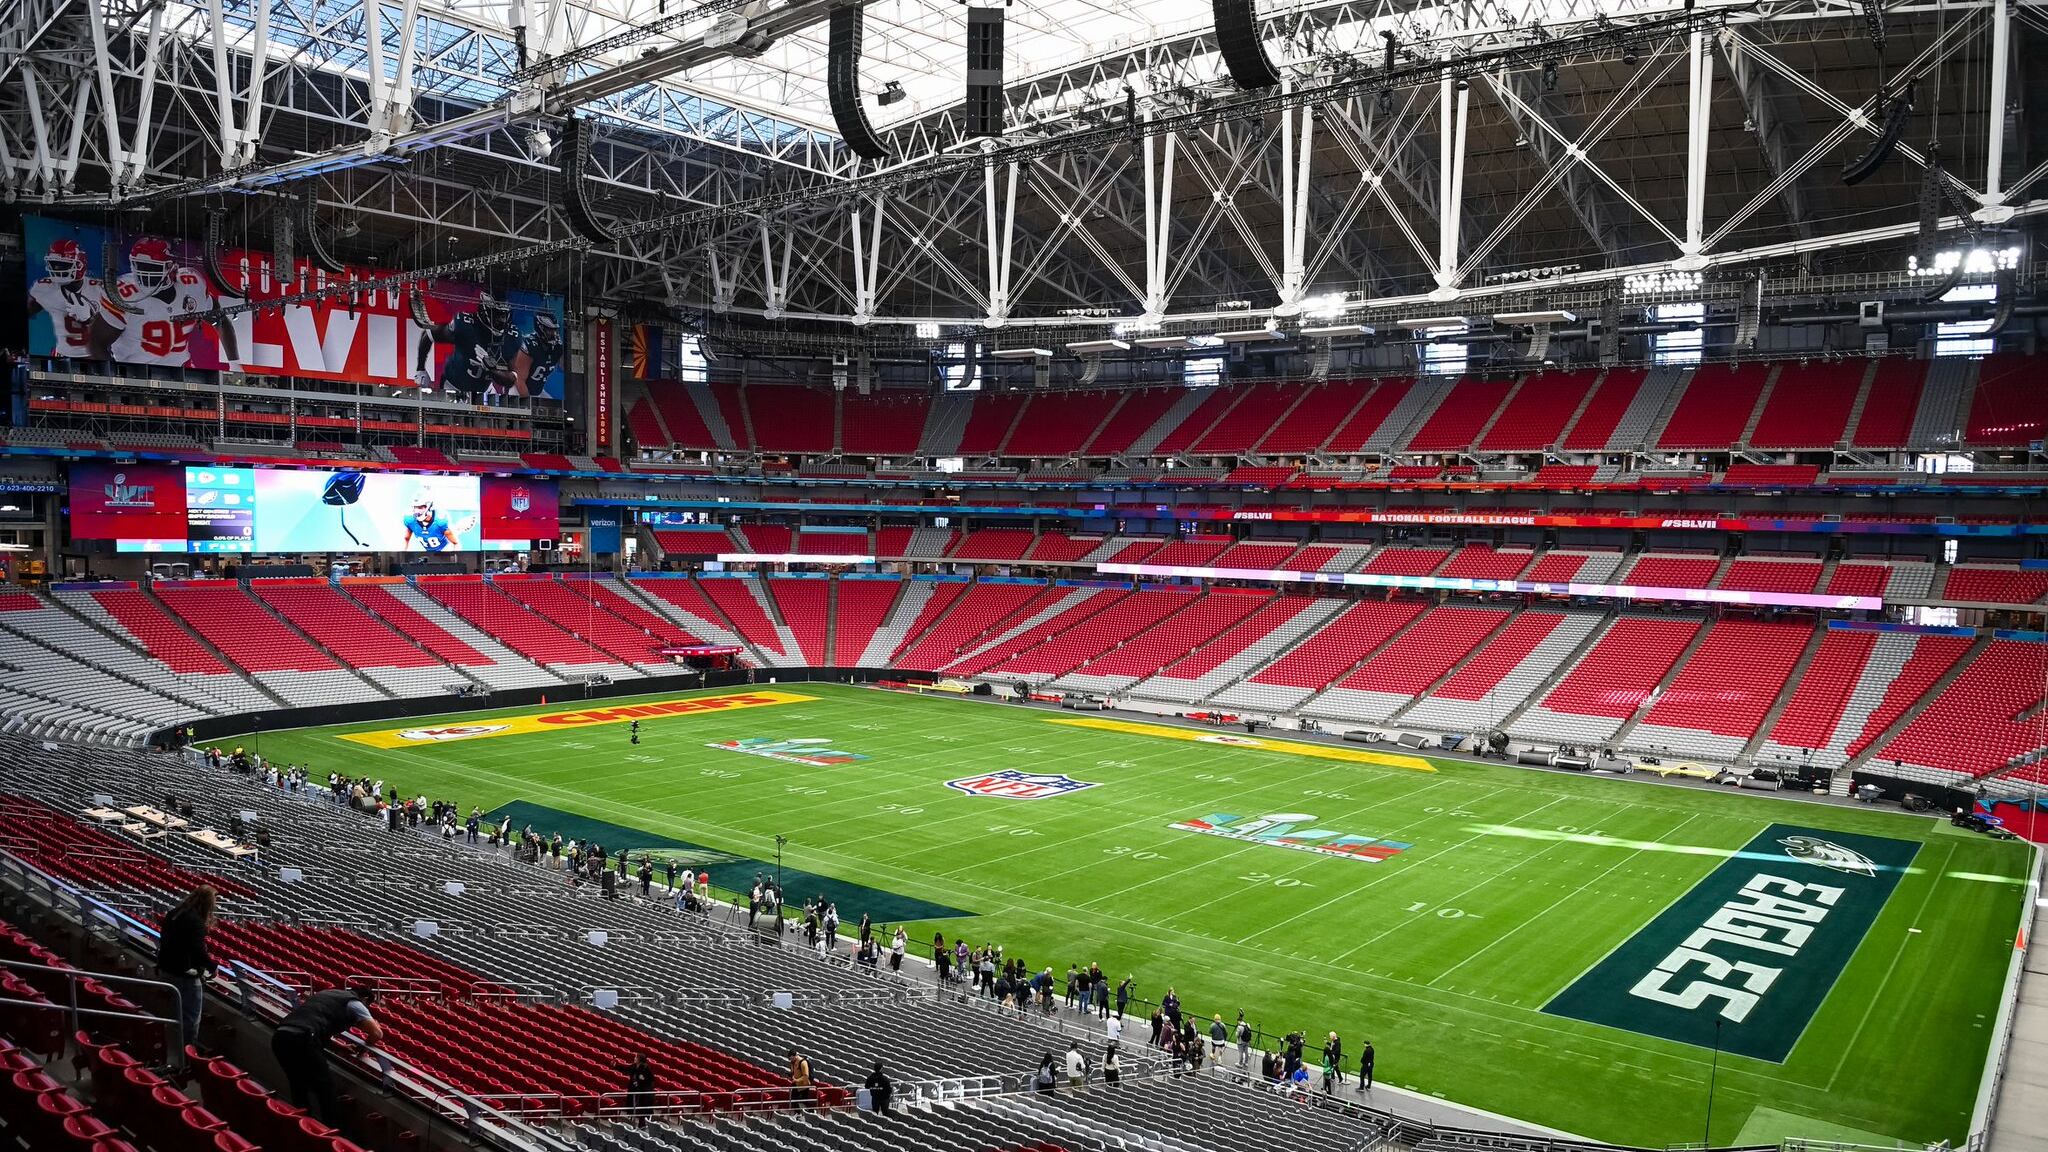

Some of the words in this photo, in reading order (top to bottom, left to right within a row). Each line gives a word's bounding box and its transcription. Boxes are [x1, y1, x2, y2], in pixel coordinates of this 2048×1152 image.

[599, 331, 607, 412] ESTABLISHED
[590, 518, 616, 527] verizon
[1233, 512, 1273, 520] #SBLVII
[1371, 514, 1426, 522] NATIONAL
[1428, 515, 1486, 524] FOOTBALL
[1488, 516, 1535, 525] LEAGUE
[1661, 519, 1717, 529] #SBLVII
[537, 694, 778, 725] CHIEFS
[961, 777, 1054, 798] NFL
[1103, 846, 1158, 860] 30
[1237, 871, 1301, 887] 20
[1401, 901, 1465, 918] 10
[1629, 872, 1846, 1023] EAGLES
